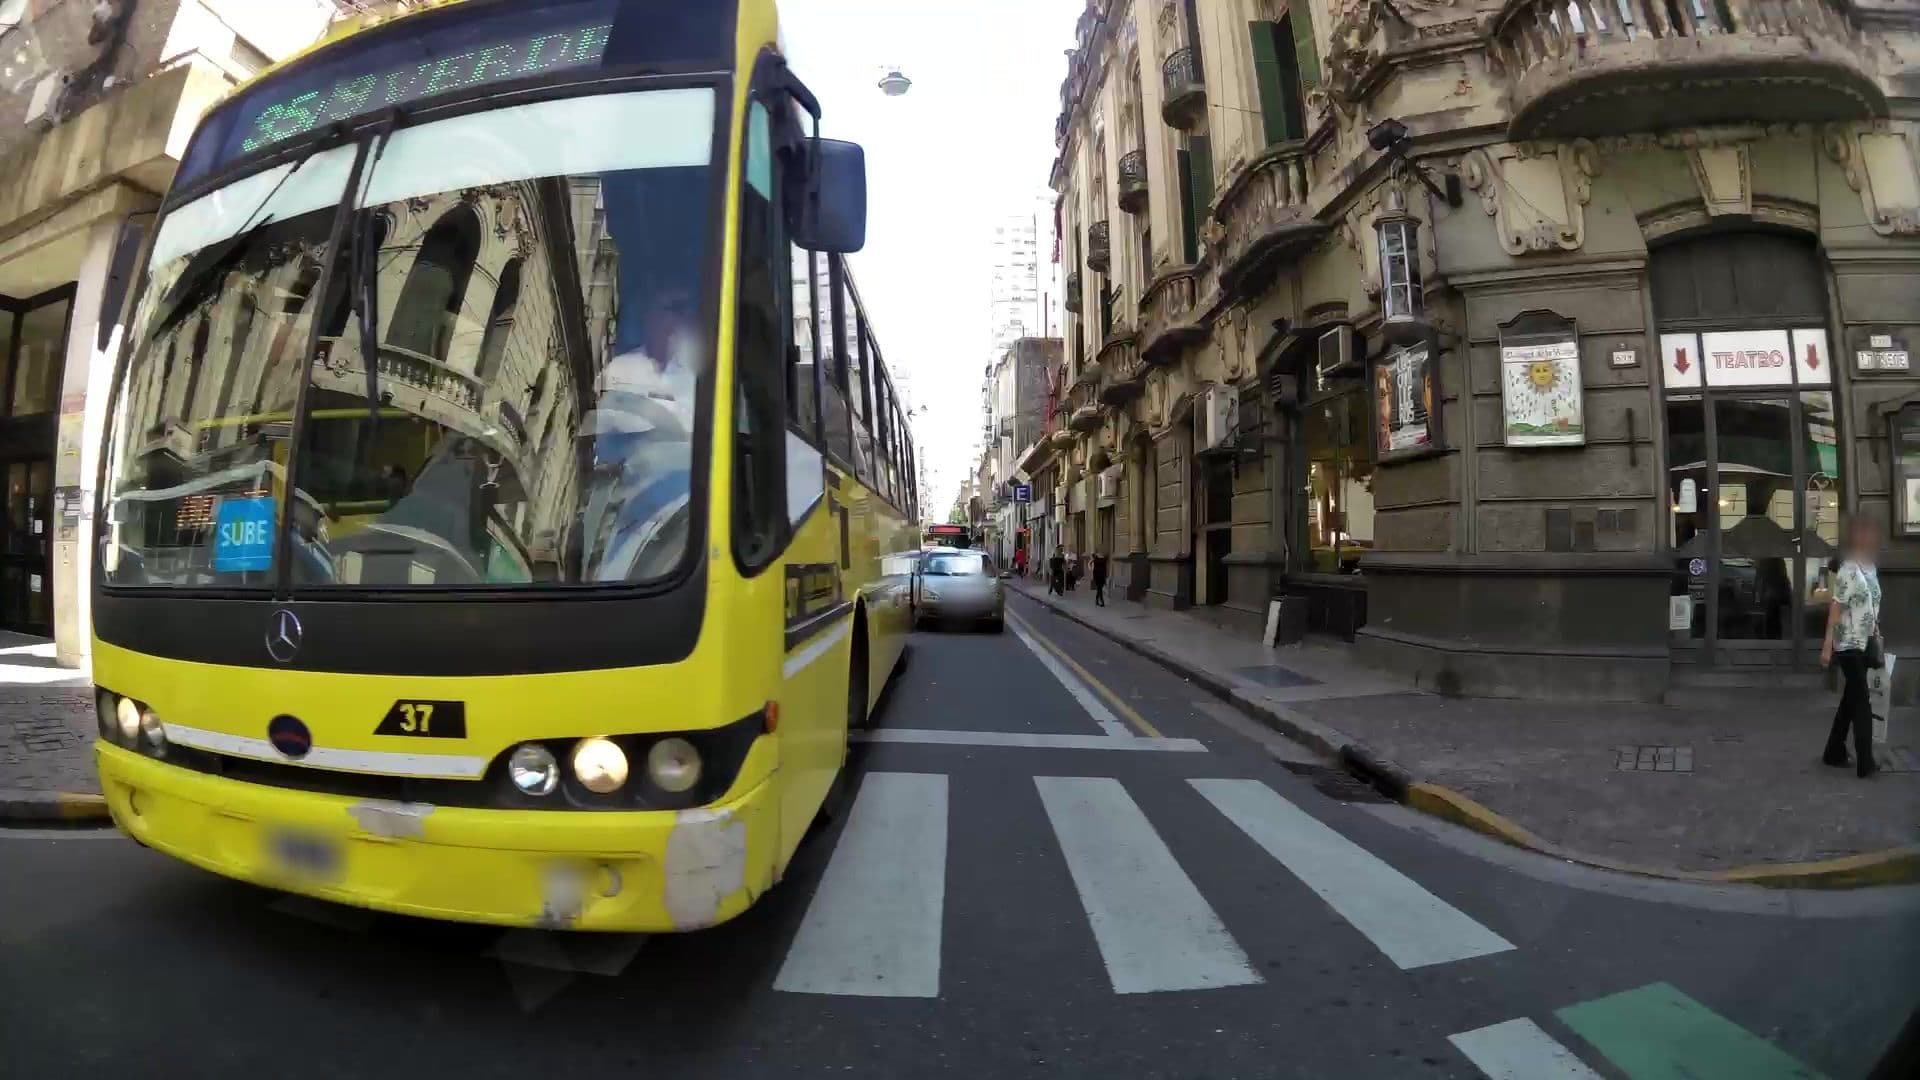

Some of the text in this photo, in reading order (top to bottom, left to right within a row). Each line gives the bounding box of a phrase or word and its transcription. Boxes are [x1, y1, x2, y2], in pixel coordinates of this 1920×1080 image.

[382, 24, 614, 104] VERDE
[1711, 350, 1785, 369] TEATRO
[1016, 487, 1028, 501] E
[221, 520, 268, 547] SUBE
[399, 703, 434, 732] 37
